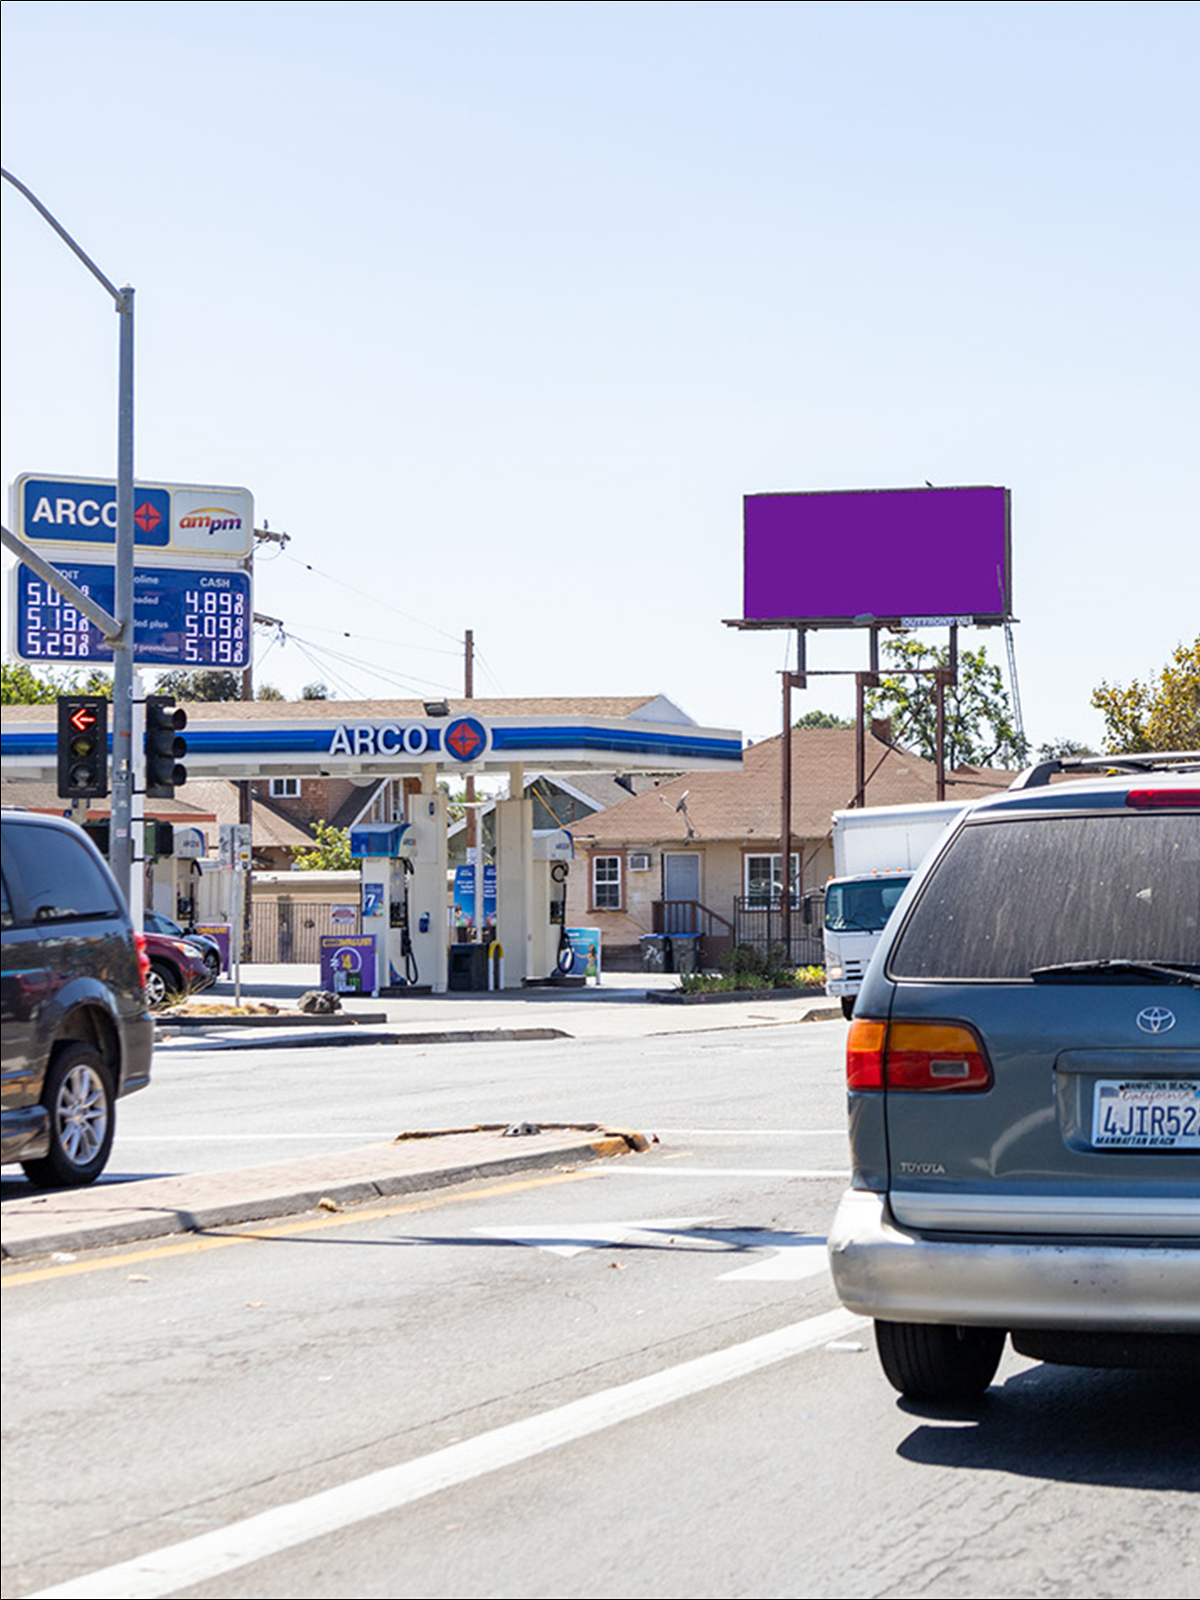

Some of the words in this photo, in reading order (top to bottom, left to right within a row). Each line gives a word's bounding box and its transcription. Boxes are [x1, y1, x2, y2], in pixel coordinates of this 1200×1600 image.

[32, 496, 118, 528] ARCO
[178, 513, 243, 535] ampm
[200, 576, 231, 589] CASH
[328, 723, 430, 757] ARCO
[1124, 1081, 1167, 1091] MANHATTAN
[1168, 1081, 1193, 1091] BEACH
[1121, 1090, 1191, 1105] California
[1094, 1136, 1148, 1146] MANHATTAN
[1148, 1136, 1177, 1146] BEACH
[900, 1161, 946, 1174] TOYOTA
